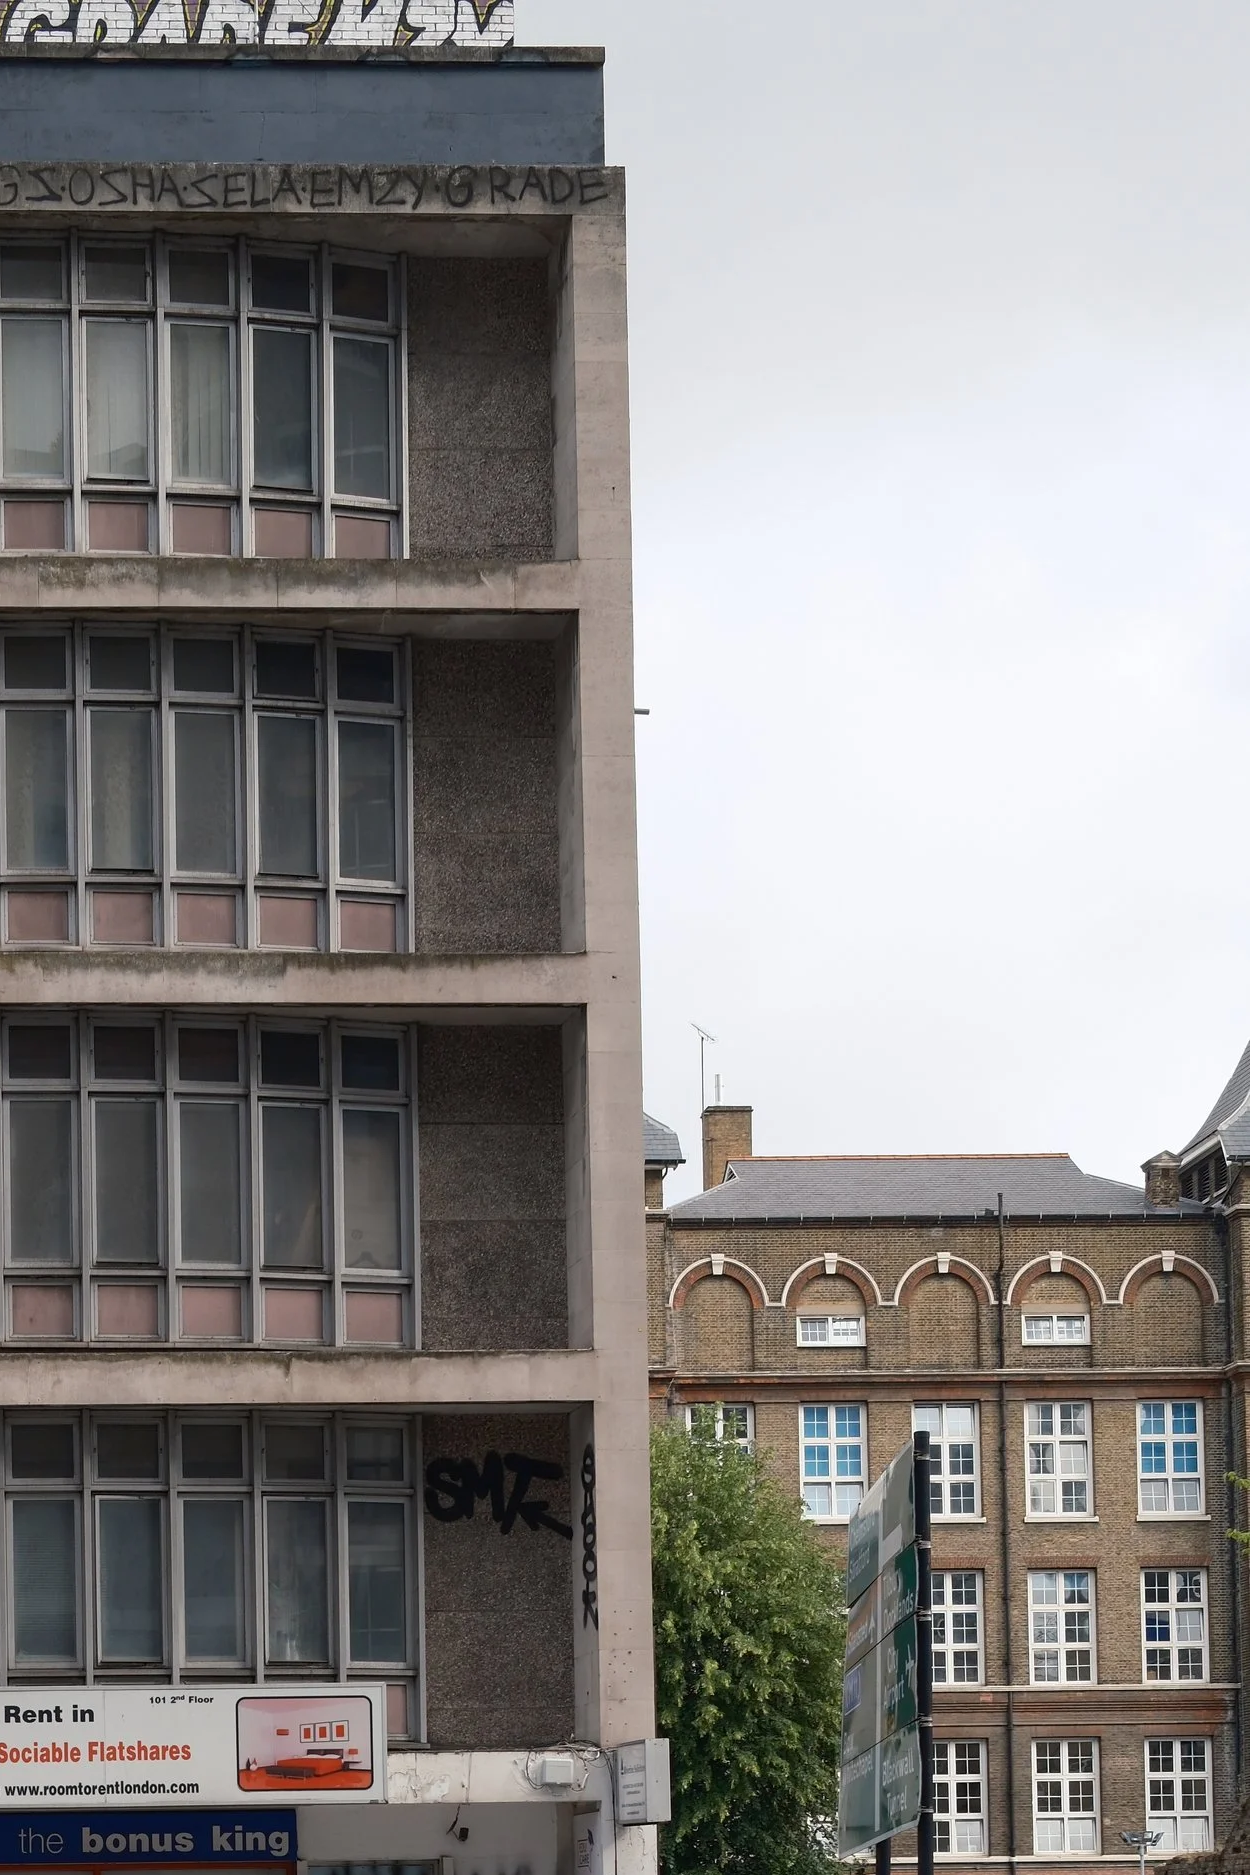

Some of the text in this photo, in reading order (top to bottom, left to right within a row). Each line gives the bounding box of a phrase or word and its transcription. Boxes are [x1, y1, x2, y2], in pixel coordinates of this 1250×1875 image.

[150, 1696, 167, 1704] 101
[188, 1695, 214, 1704] Floor
[4, 1706, 63, 1723] Rent
[72, 1705, 94, 1723] in
[88, 1741, 191, 1763] Flatshares
[882, 1748, 915, 1787] Blackwall
[4, 1779, 199, 1797] www.roomtorentlondon.com
[19, 1828, 64, 1854] the
[82, 1827, 194, 1853] bonus
[212, 1825, 289, 1857] king
